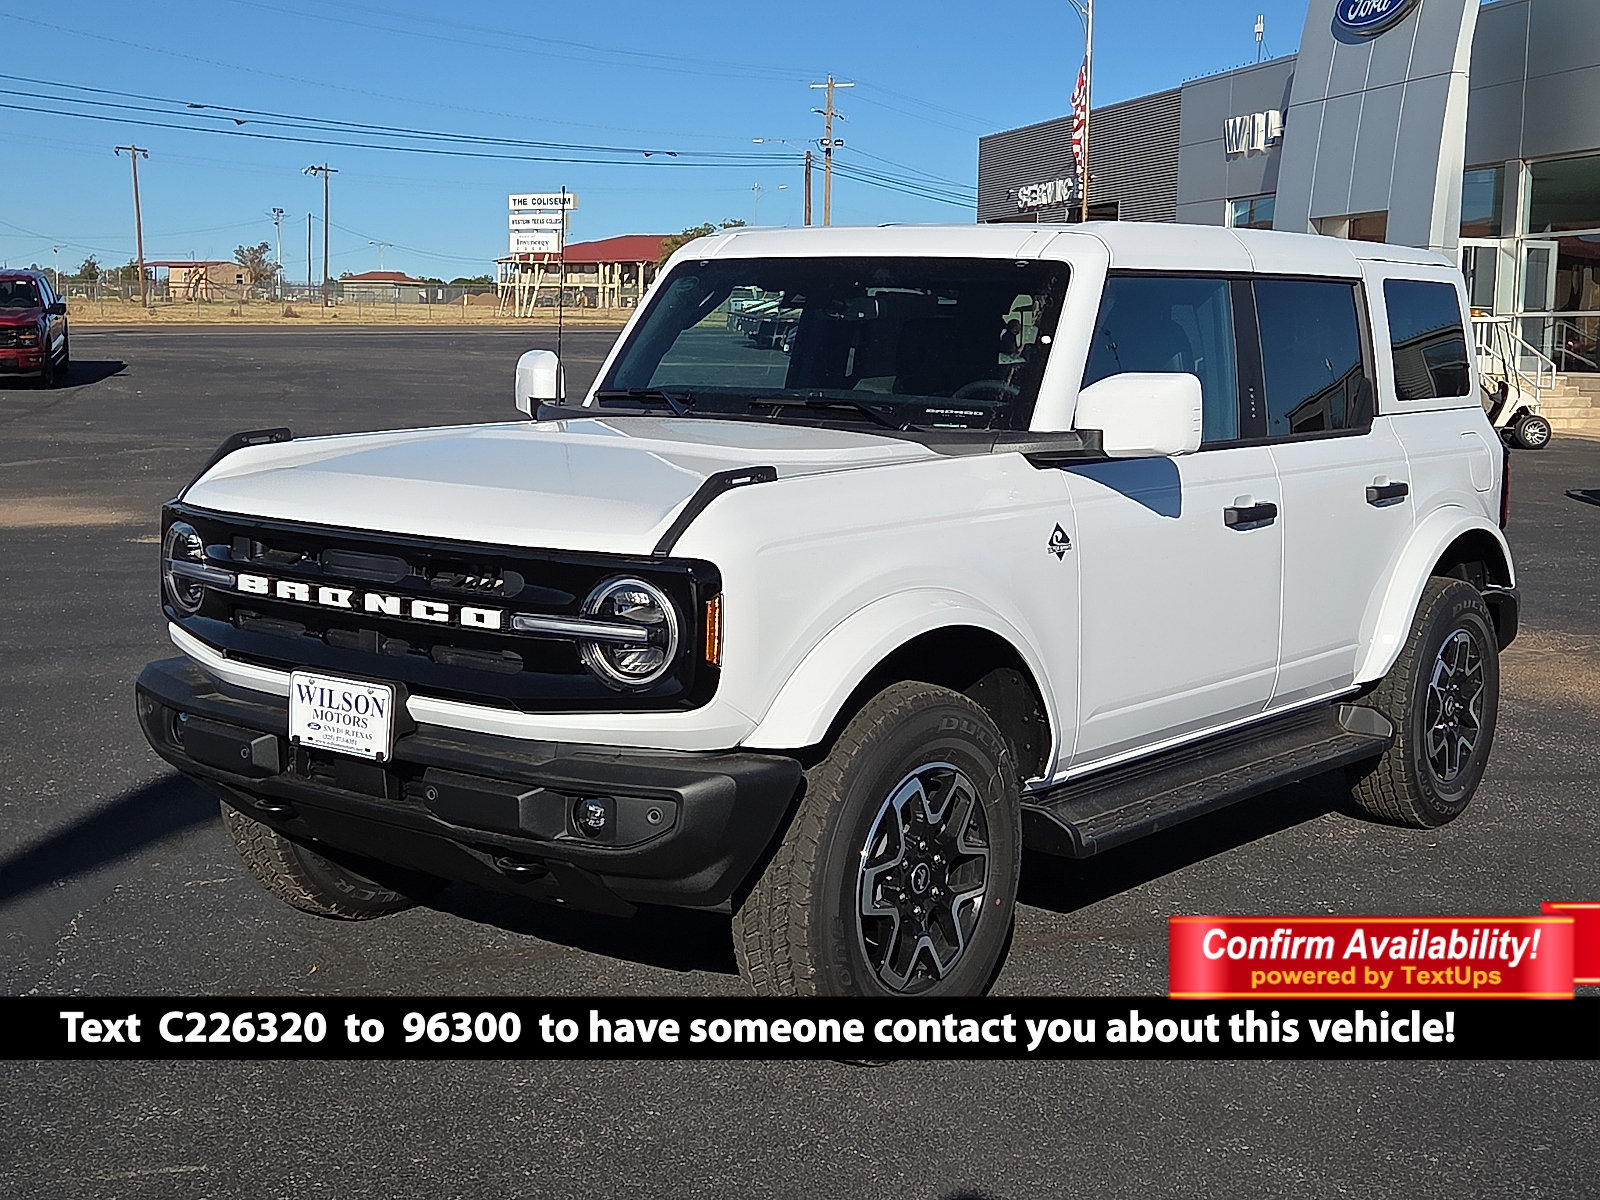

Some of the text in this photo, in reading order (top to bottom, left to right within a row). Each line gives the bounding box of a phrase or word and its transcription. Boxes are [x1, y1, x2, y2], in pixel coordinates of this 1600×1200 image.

[1224, 110, 1288, 154] WIL
[512, 197, 571, 206] THE COLISEUM
[237, 573, 503, 630] BRONCO
[296, 683, 386, 719] WILSON
[312, 708, 369, 729] MOTORS
